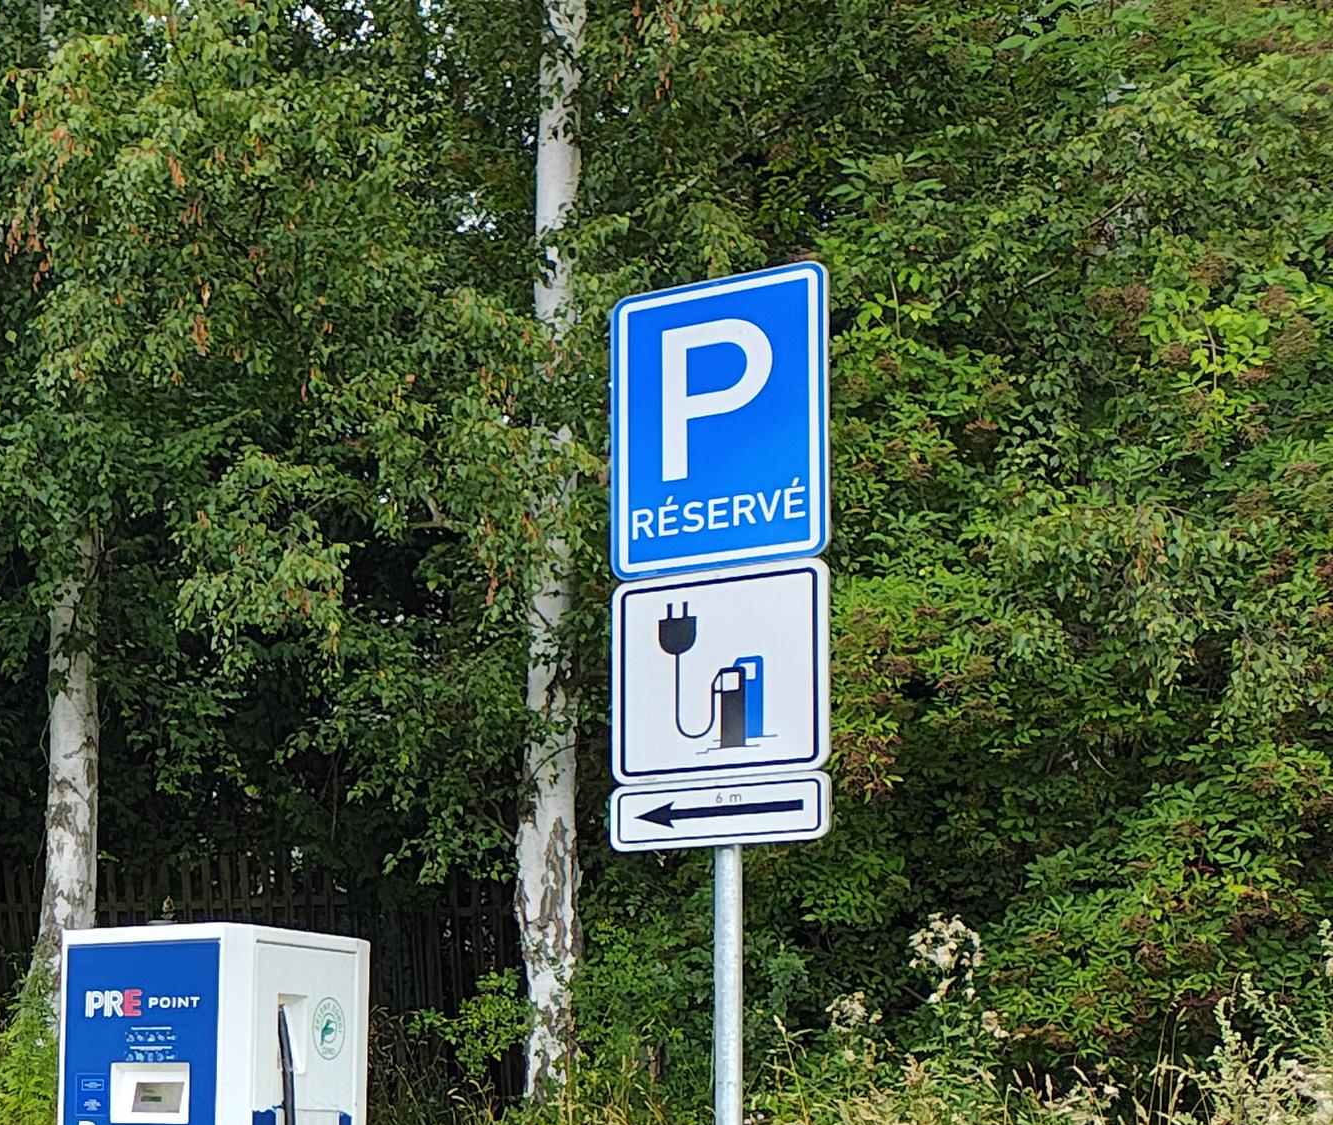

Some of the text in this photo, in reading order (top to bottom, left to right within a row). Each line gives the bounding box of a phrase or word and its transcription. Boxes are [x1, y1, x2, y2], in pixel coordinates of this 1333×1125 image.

[661, 317, 773, 482] P
[631, 477, 807, 541] RÉSERVÉ
[715, 791, 742, 803] 6 m
[85, 988, 201, 1018] PRE POINT
